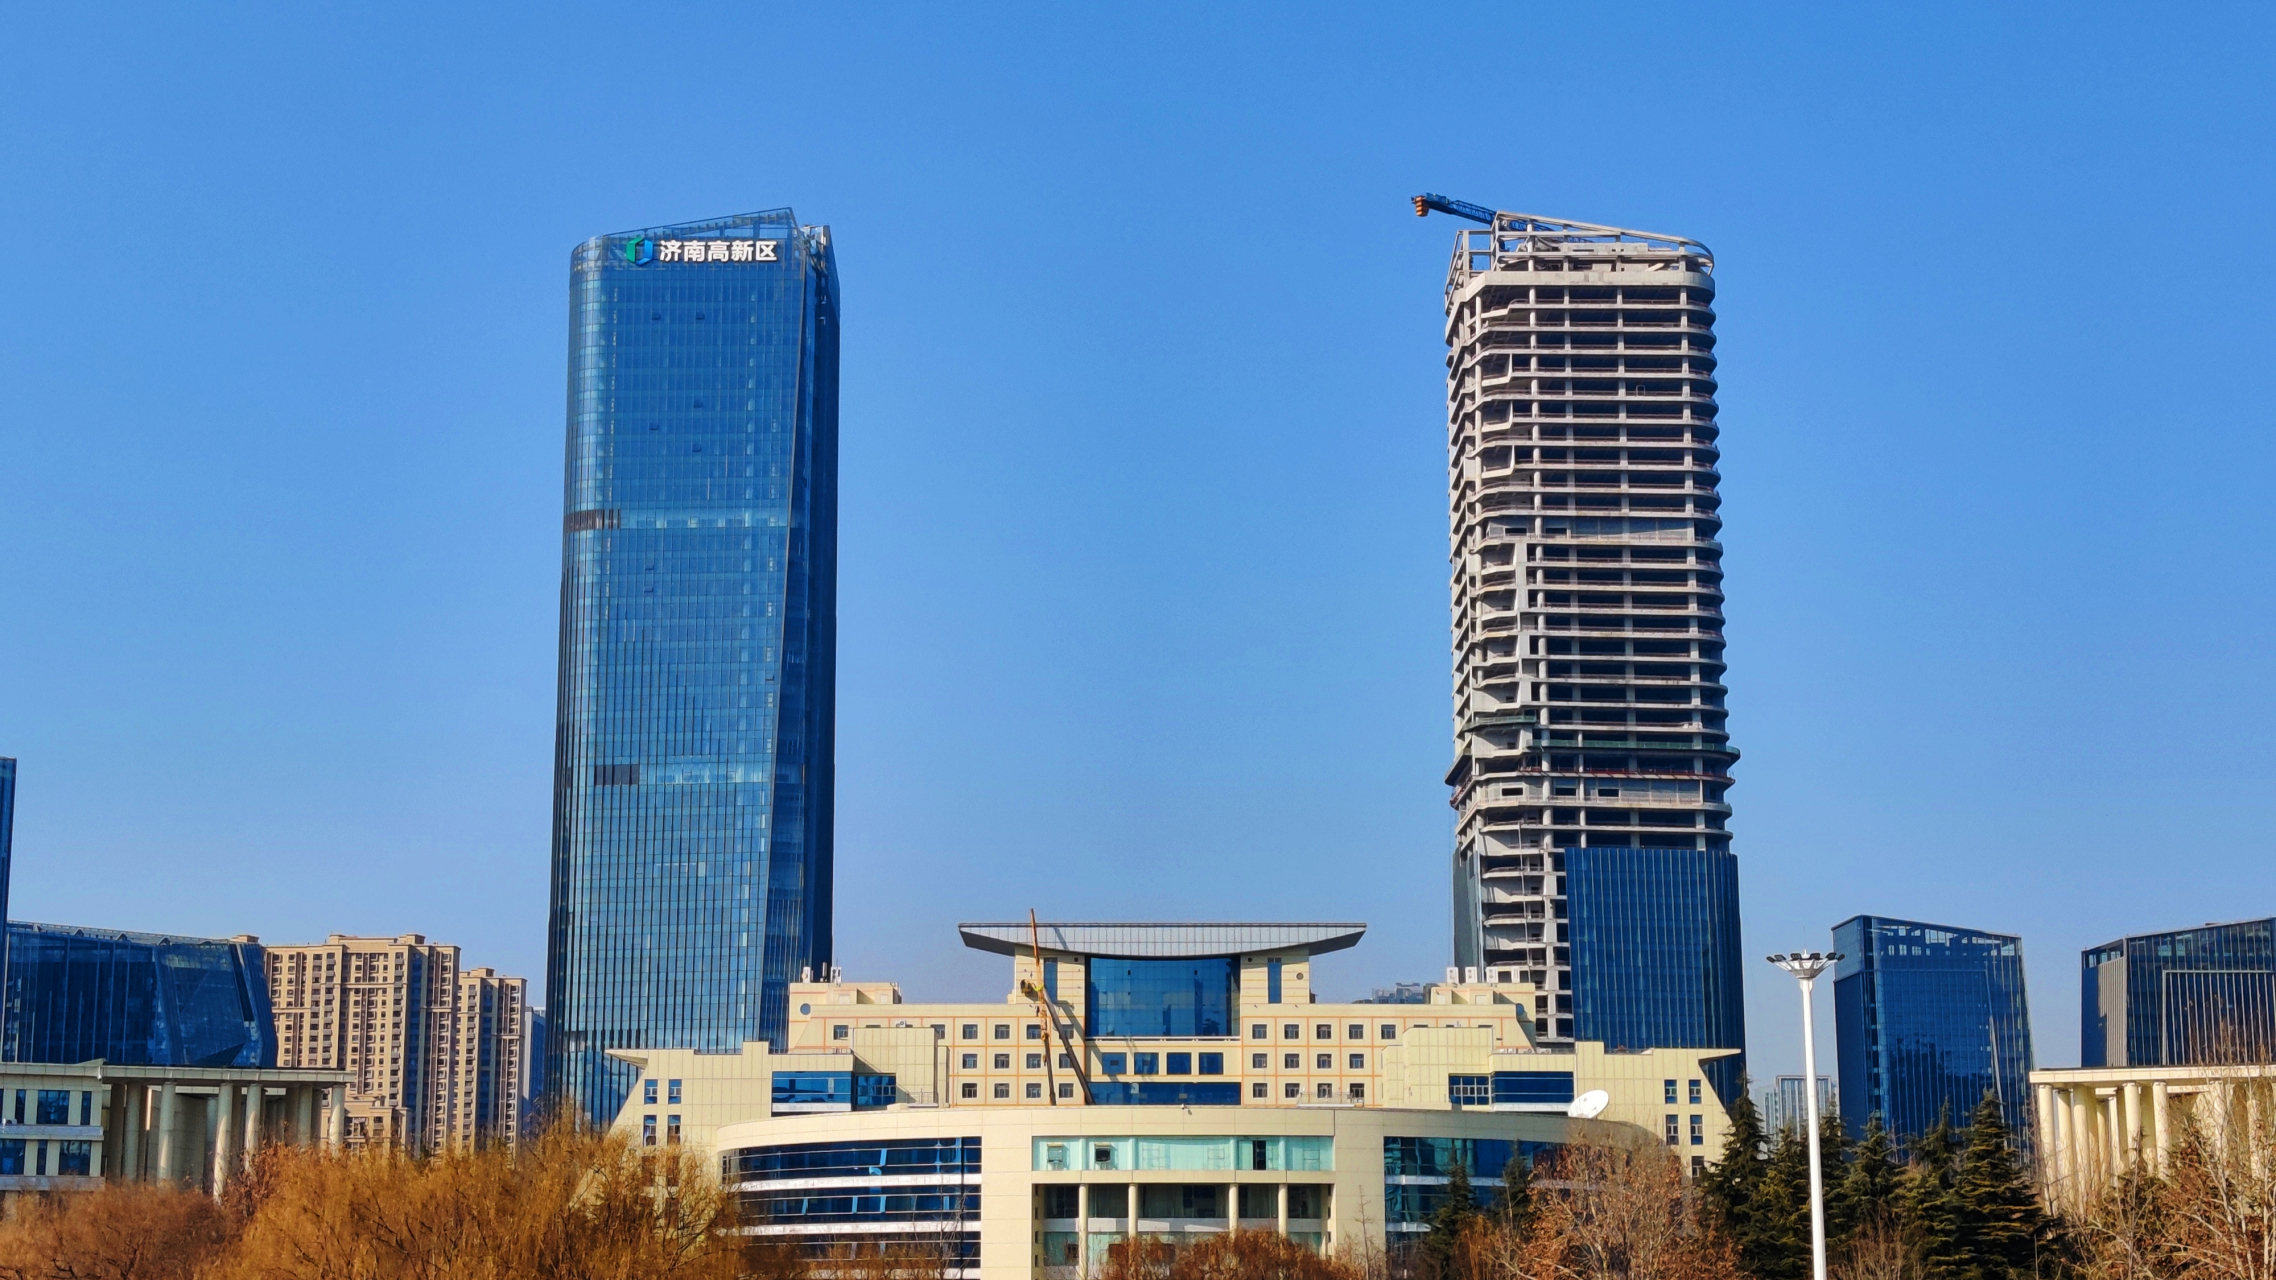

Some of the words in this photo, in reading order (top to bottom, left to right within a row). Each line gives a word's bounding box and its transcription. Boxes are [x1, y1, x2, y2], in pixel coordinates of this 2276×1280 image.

[659, 240, 777, 262] 济南高新区
